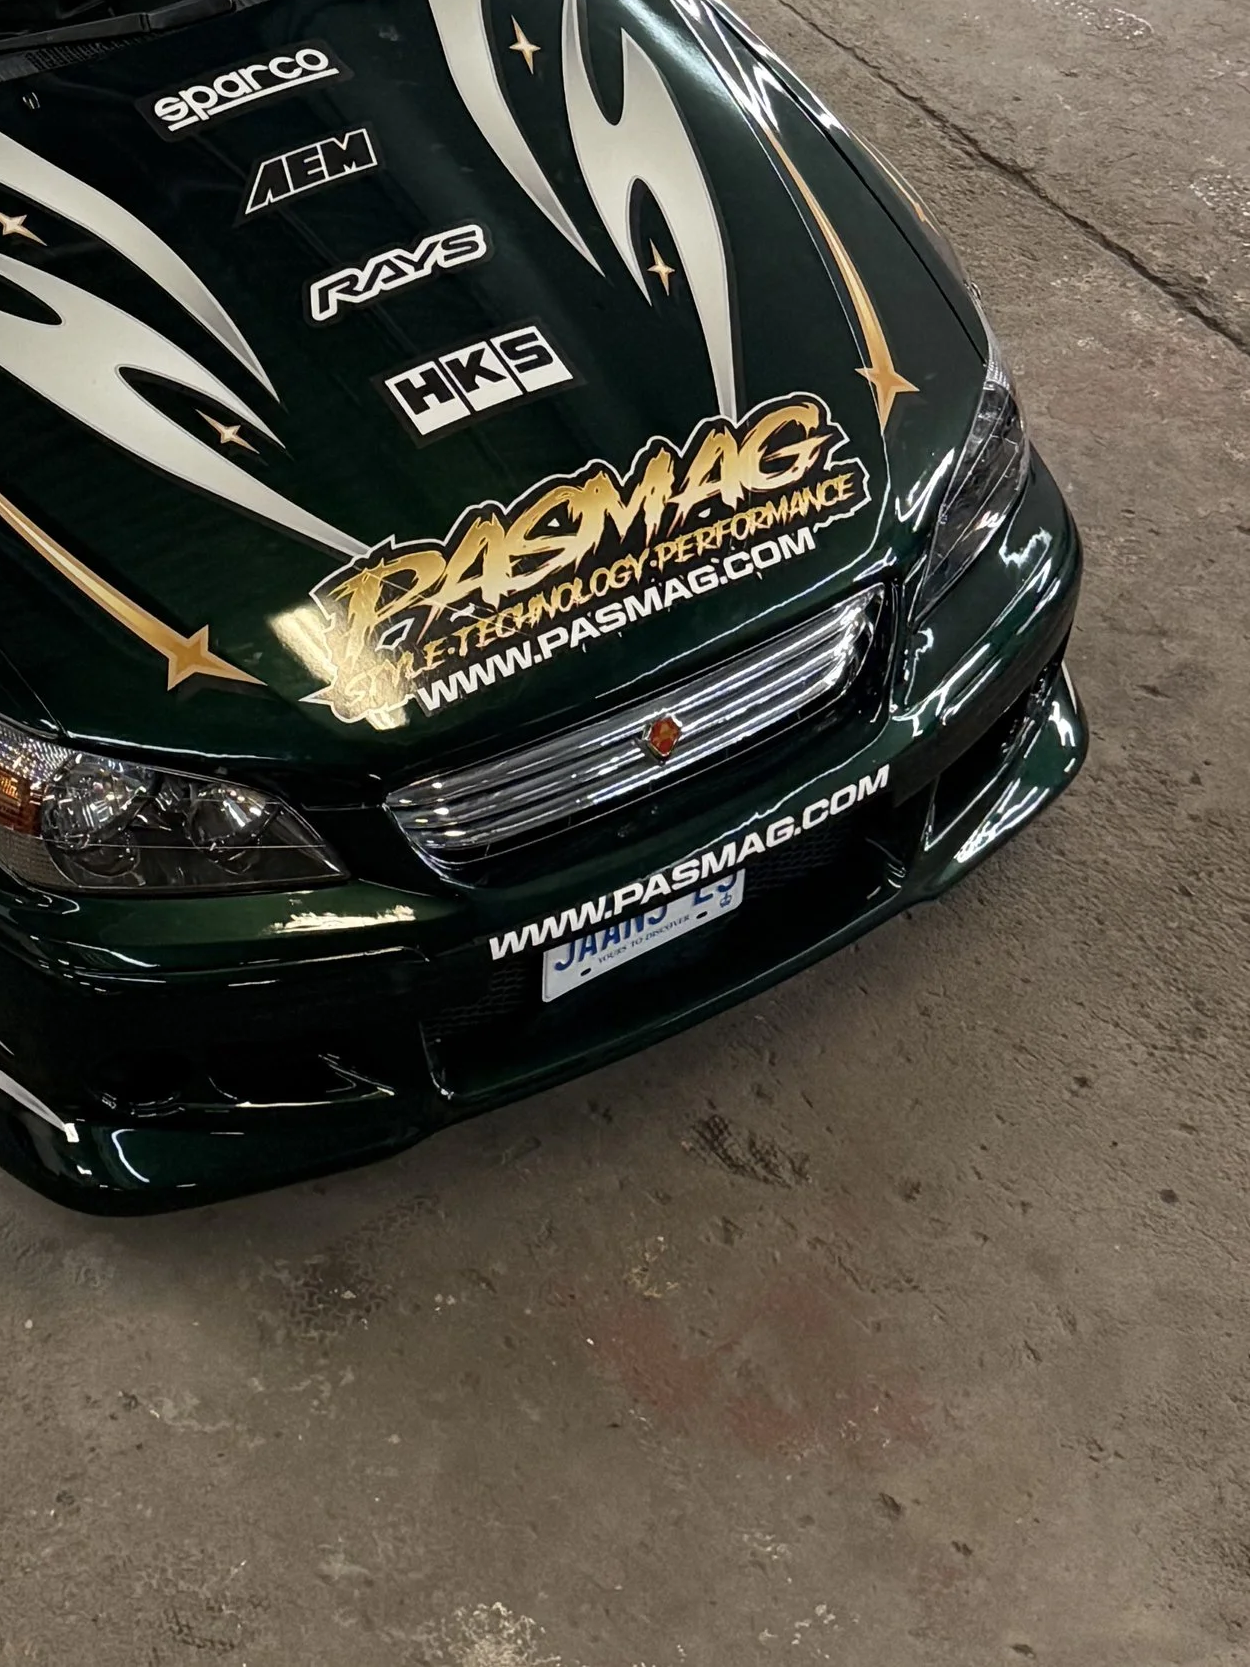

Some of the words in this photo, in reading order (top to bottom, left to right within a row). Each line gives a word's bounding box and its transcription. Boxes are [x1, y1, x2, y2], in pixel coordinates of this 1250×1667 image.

[154, 47, 337, 130] sparco
[244, 128, 379, 215] AEM
[314, 227, 484, 319] RAYS
[389, 329, 564, 426] HKS
[326, 401, 834, 669] PASMAG
[417, 526, 817, 712] WWW.PASMAG.COM
[488, 764, 891, 962] WWW.PASMAG.COM
[598, 945, 628, 965] YOURS
[631, 936, 644, 949] TO
[645, 913, 691, 942] DISCOVER
